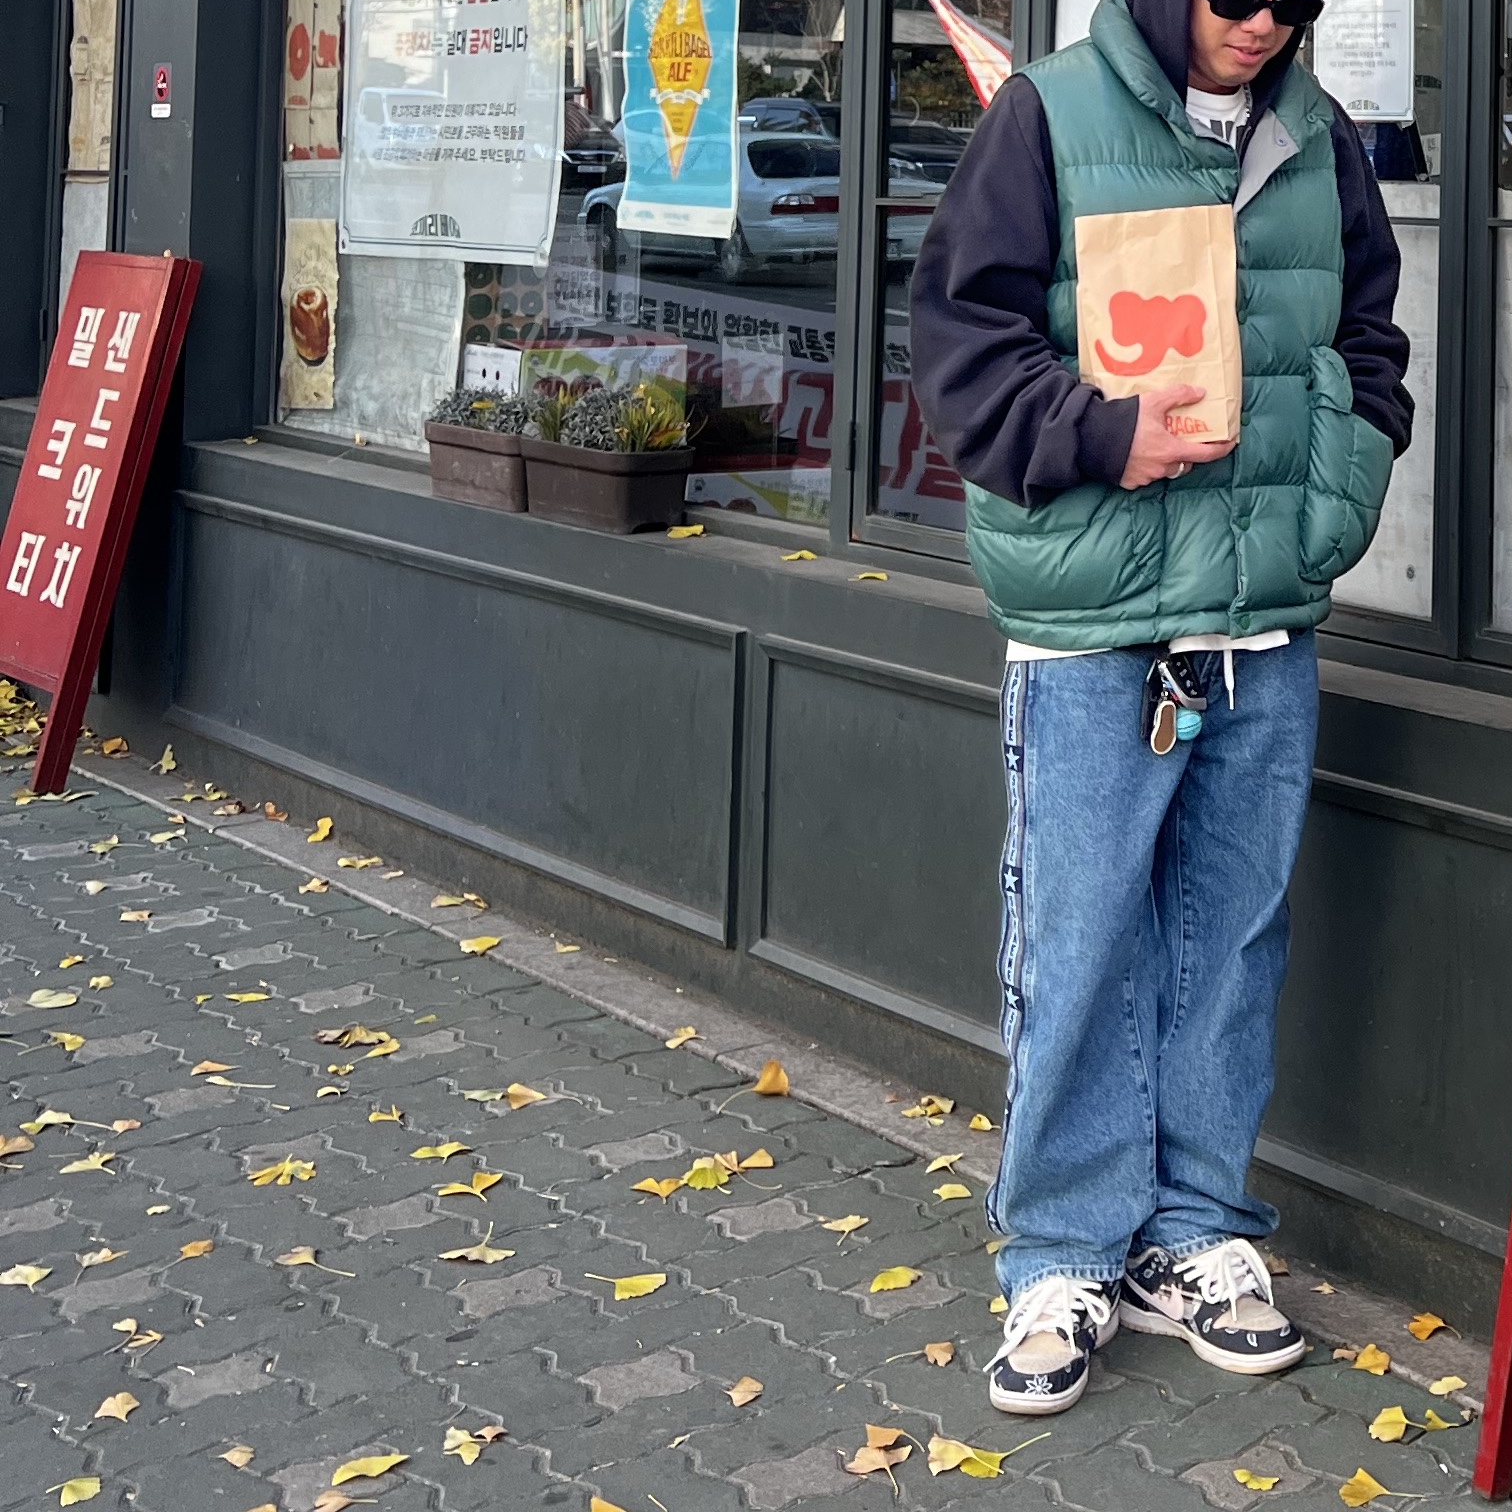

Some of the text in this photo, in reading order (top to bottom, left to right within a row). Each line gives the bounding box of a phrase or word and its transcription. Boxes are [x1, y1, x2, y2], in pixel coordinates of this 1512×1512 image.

[447, 29, 468, 56] 절대
[469, 25, 528, 55] 금지입니다
[668, 62, 693, 82] ALE
[1165, 415, 1213, 435] BAGEL
[40, 310, 142, 608] 샌드위치
